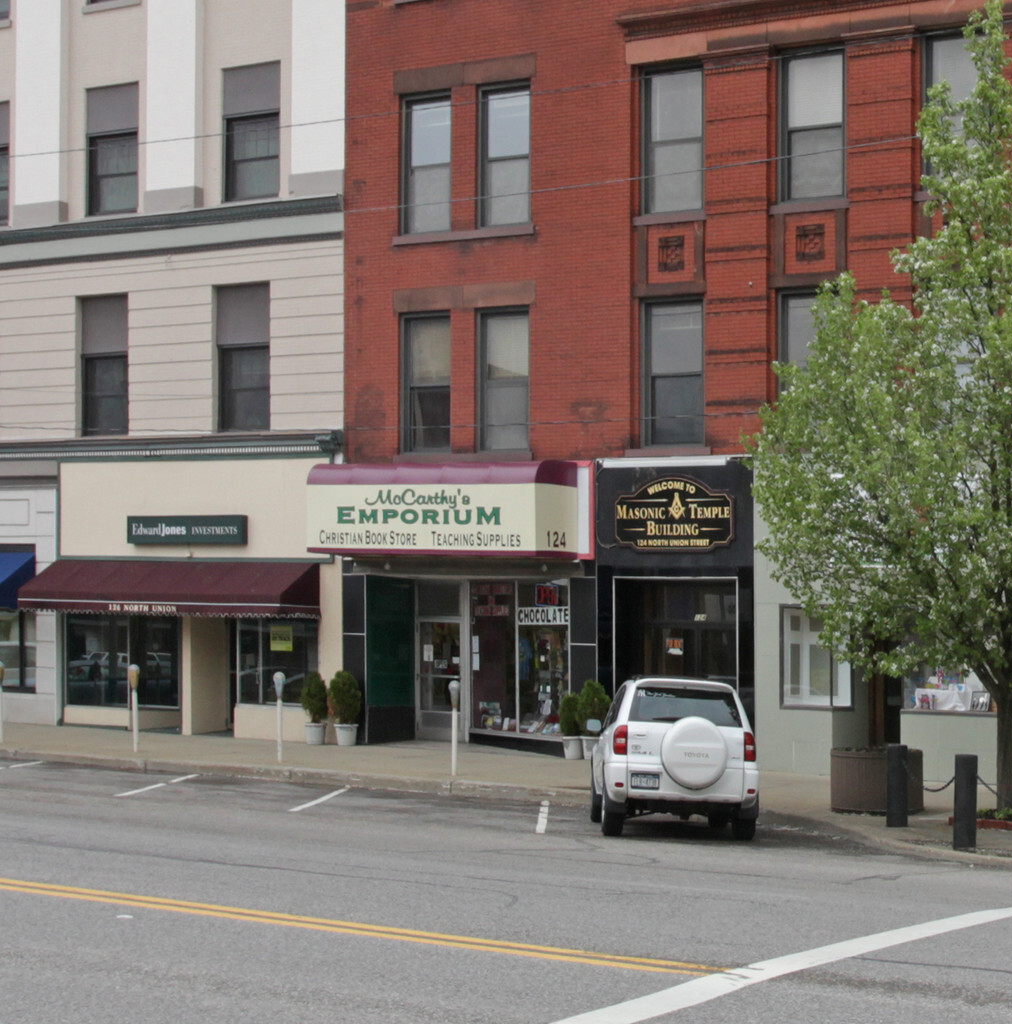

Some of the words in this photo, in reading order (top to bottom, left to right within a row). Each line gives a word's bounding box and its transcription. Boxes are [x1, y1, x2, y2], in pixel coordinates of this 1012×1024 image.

[647, 481, 684, 495] WELCOME
[686, 482, 696, 494] TO
[364, 488, 471, 509] McCarthy's
[336, 506, 501, 525] EMPORIUM
[616, 505, 665, 519] MASONIC
[689, 504, 731, 519] TEMPLE
[191, 525, 238, 536] INVESTMENTS
[647, 521, 698, 535] BUILDING
[319, 529, 363, 545] CHRISTIAN
[365, 529, 388, 545] BOOK
[389, 530, 417, 546] STORE
[431, 531, 475, 547] TEACHING
[476, 531, 521, 548] SUPPLIES
[547, 531, 567, 548] 124
[123, 604, 149, 612] NORTH
[151, 604, 177, 612] UNION
[519, 608, 569, 623] CHOCOLATE
[684, 751, 710, 759] TOYOTA
